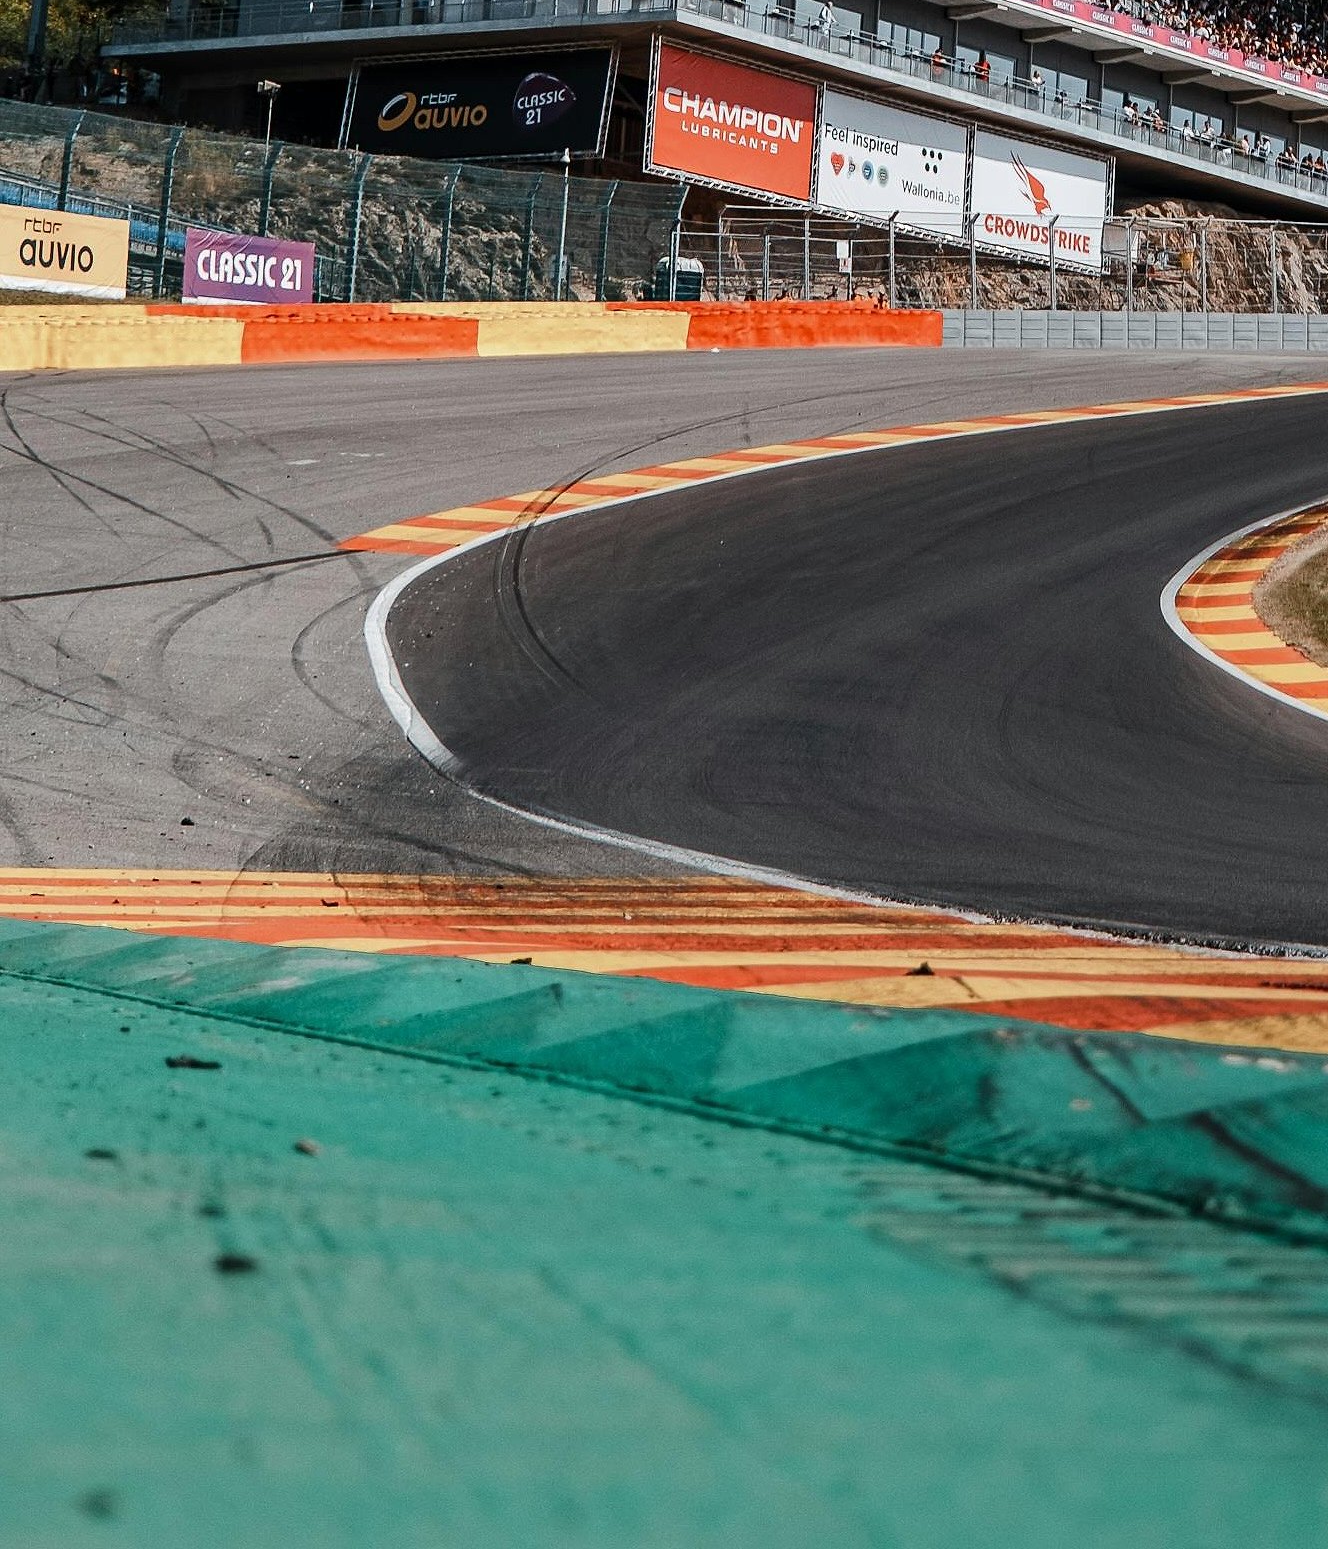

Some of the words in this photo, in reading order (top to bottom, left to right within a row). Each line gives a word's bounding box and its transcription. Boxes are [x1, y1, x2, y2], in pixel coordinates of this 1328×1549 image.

[421, 93, 457, 105] rtbf
[517, 88, 566, 109] CLASSIC
[525, 108, 541, 125] 21
[663, 87, 800, 143] CHAMPION
[682, 121, 778, 154] LUBRICANTS
[825, 123, 849, 143] Feel
[853, 129, 899, 156] inspired
[902, 179, 960, 205] Wallonia.be
[24, 217, 62, 234] rtbf
[197, 249, 276, 288] CLASSIC
[280, 258, 302, 290] 21
